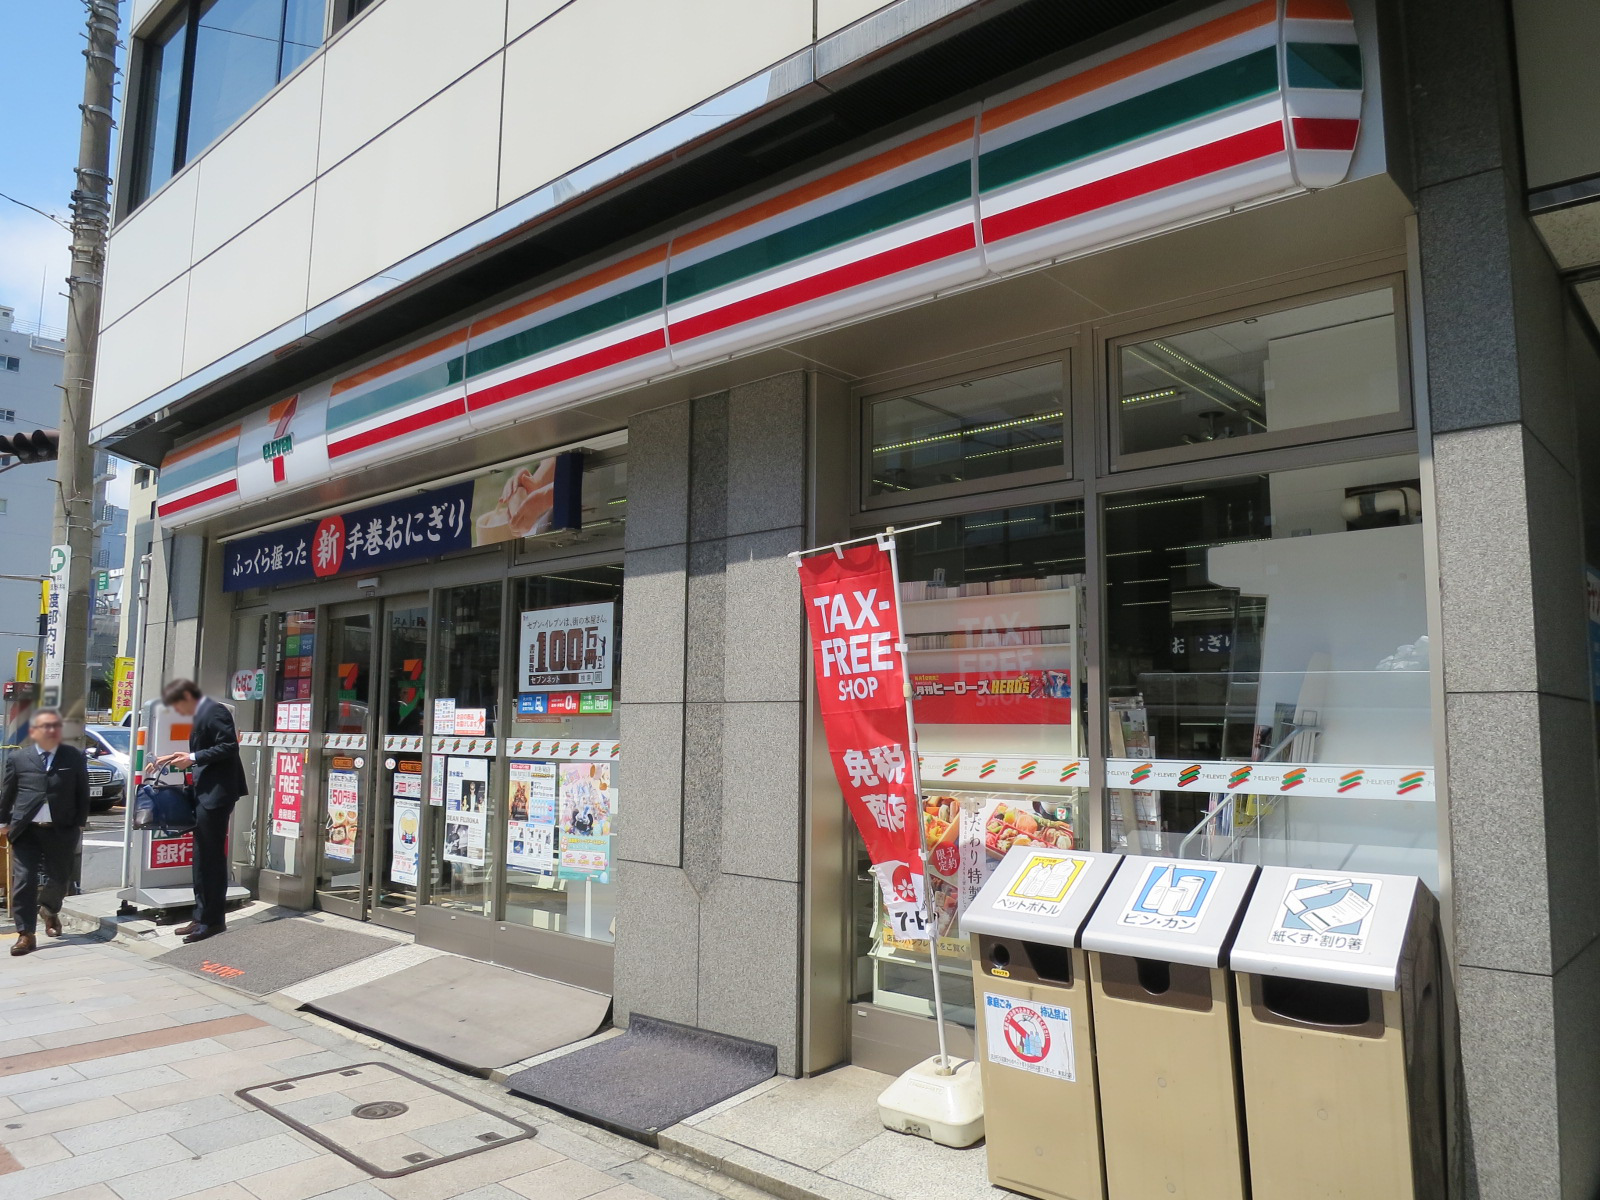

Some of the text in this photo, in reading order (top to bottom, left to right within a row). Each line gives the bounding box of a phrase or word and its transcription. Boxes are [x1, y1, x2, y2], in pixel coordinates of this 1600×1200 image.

[262, 433, 294, 461] ELEVEN
[232, 498, 465, 577] ふっくら握った 新 手巻おにぎり
[813, 588, 891, 635] TAX-
[820, 631, 894, 678] FREE
[838, 677, 879, 700] SHOP
[916, 680, 991, 697] 月刊ヒーローズ
[279, 754, 301, 774] TAX-
[842, 744, 906, 788] 免税
[278, 774, 300, 794] FREE
[1253, 775, 1280, 783] 7-ELEVEN
[281, 794, 296, 805] SHOP
[936, 848, 949, 872] 限定
[946, 846, 959, 870] 予約
[997, 898, 1060, 915] ペットボトル
[1123, 913, 1196, 930] ビン・カン
[1271, 930, 1364, 951] 紙くず・割り箸
[986, 995, 1069, 1022] 家庭ごみ 持込禁止
